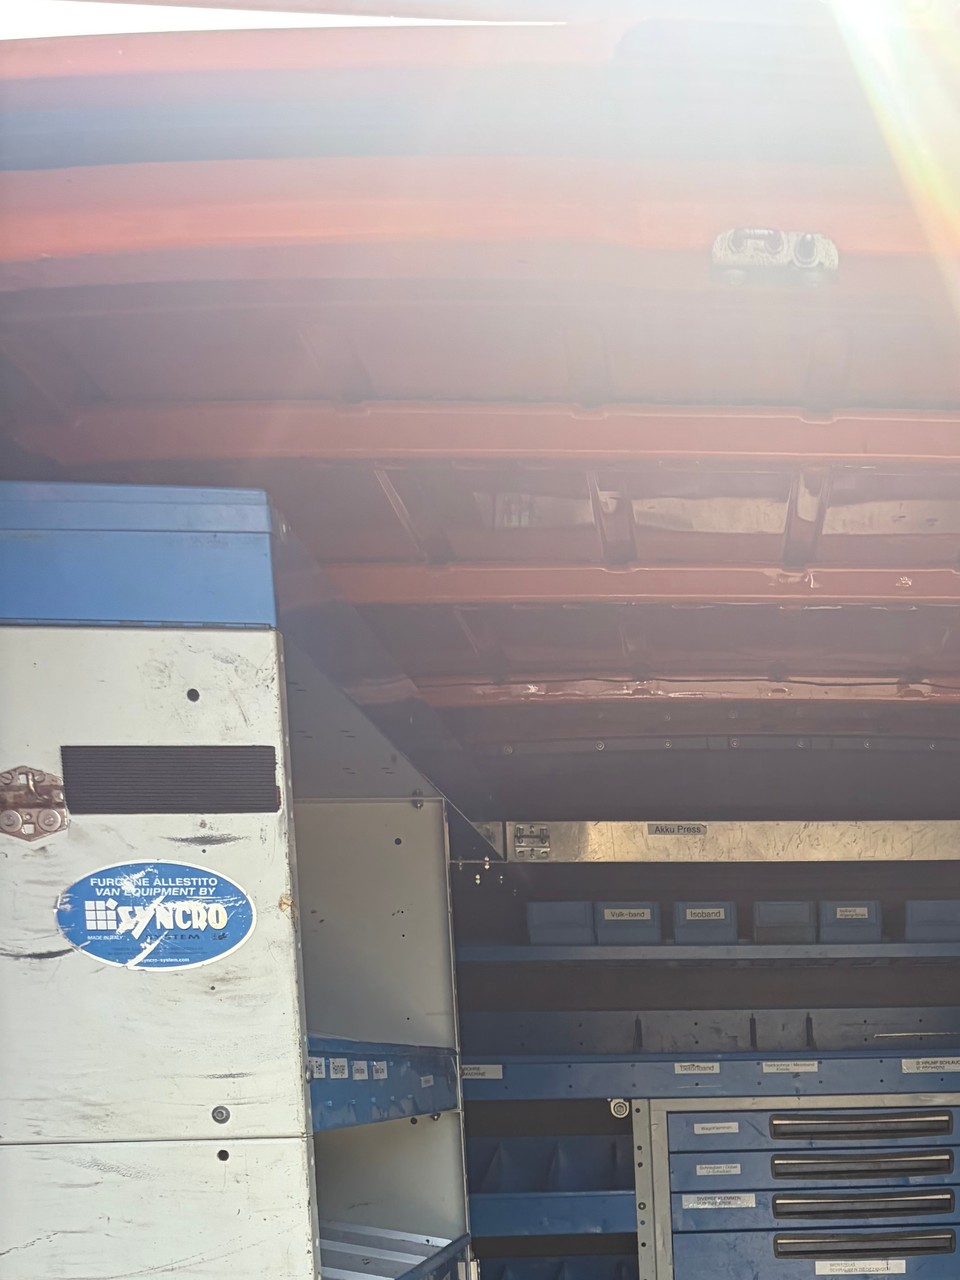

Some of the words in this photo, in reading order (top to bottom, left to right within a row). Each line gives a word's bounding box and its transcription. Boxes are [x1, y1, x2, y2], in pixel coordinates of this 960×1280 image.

[654, 825, 675, 834] Akku
[677, 825, 702, 834] Press
[90, 877, 149, 887] FURGNE
[153, 877, 218, 887] ALLESTITO
[95, 887, 121, 896] VAN
[124, 887, 196, 897] EQUIPMENT
[199, 887, 216, 896] BY
[610, 910, 646, 918] Vulk-band
[690, 910, 721, 918] Isoband
[117, 902, 228, 940] SYNCRO
